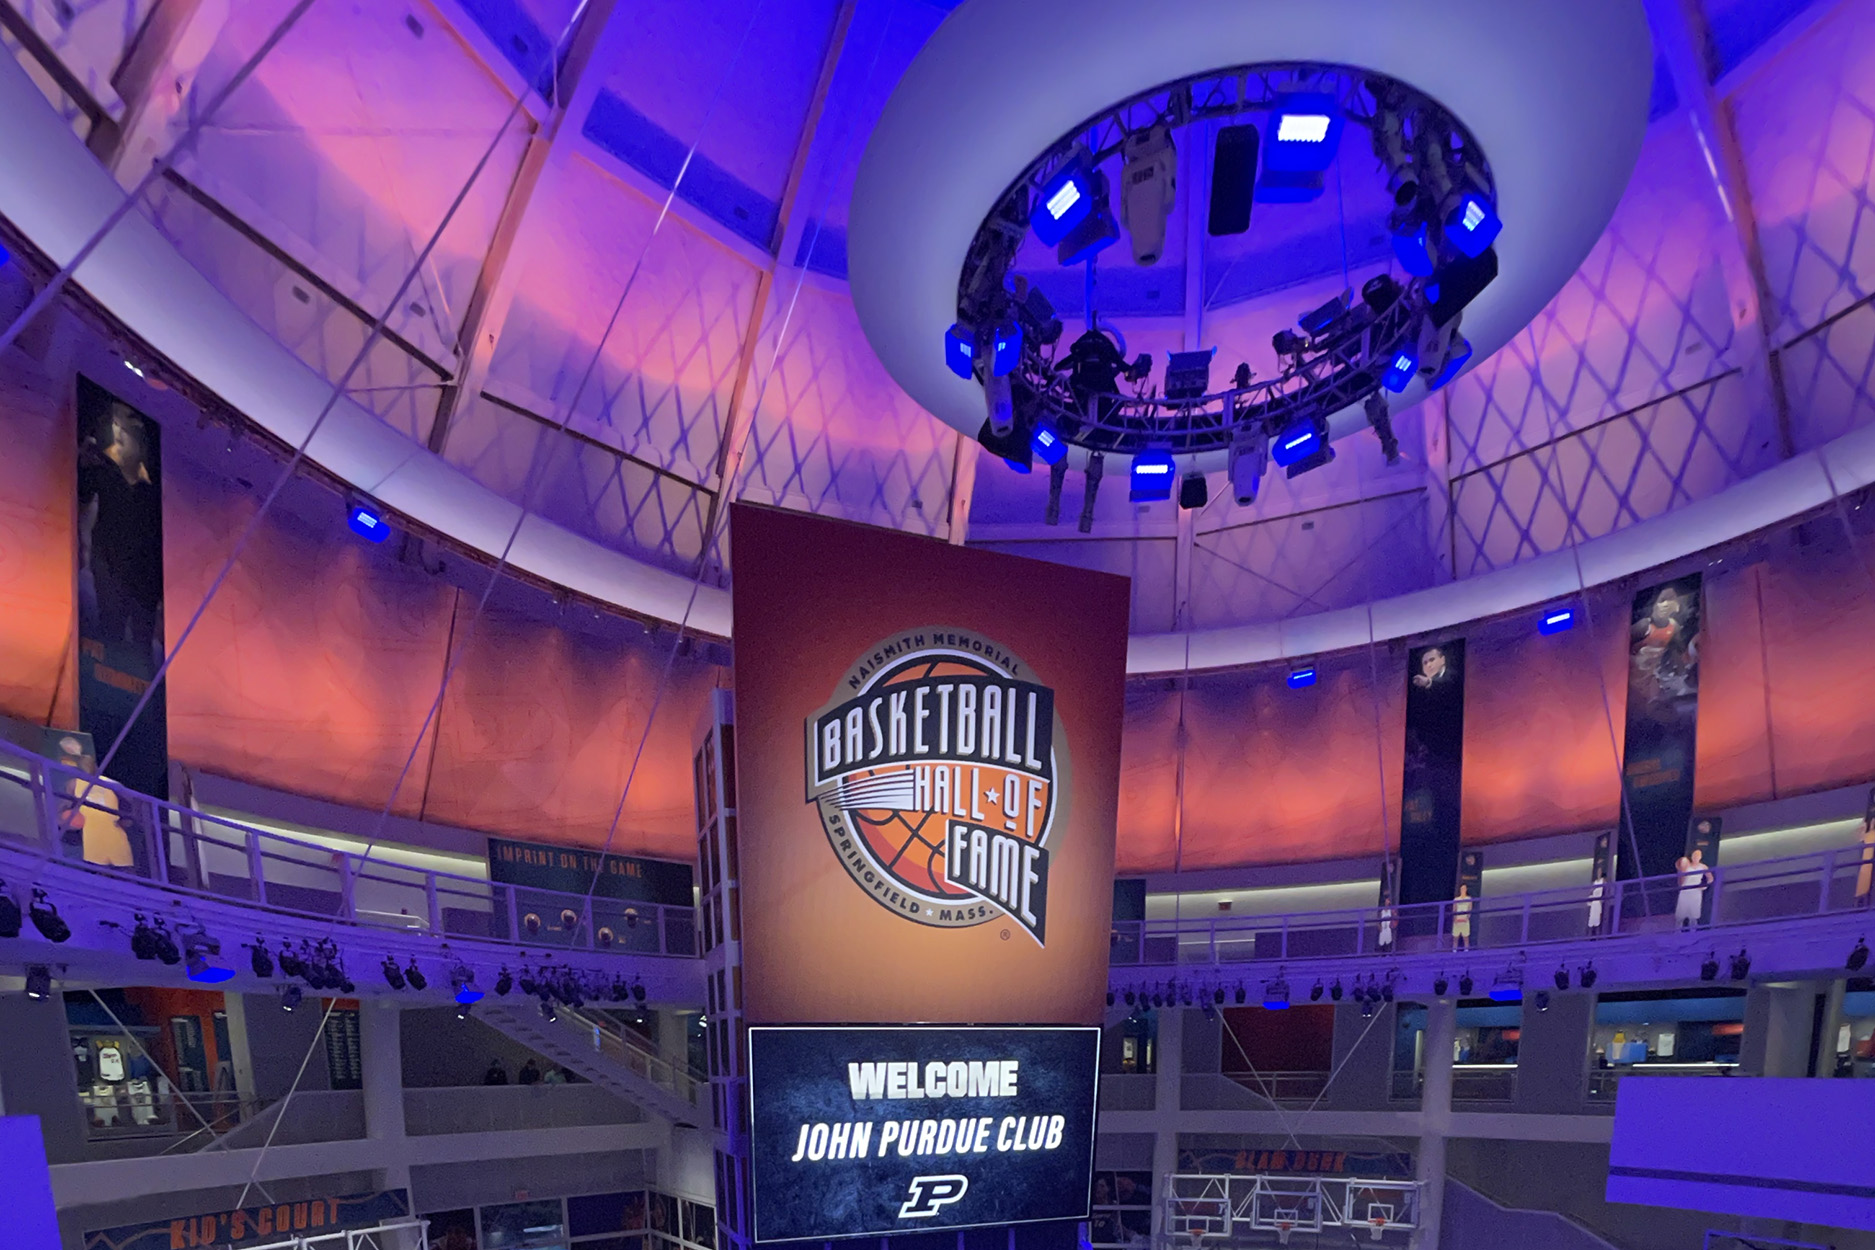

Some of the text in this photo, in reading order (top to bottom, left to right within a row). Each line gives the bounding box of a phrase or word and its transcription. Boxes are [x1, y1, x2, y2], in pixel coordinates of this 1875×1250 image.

[848, 633, 1019, 690] NAISMITH MEMORIAL
[822, 683, 1043, 770] BASKETBALL
[914, 765, 1043, 838] HALL OF
[497, 845, 554, 867] IMPRINT
[560, 853, 577, 869] ON
[610, 859, 643, 878] GAME
[827, 813, 994, 922] SPRINGFIELD MASS.
[953, 825, 1040, 929] FAME
[848, 1060, 1019, 1100] WELCOME
[791, 1114, 1066, 1162] JOHN PURDUE CLUB
[169, 1198, 340, 1250] KID'S COURT
